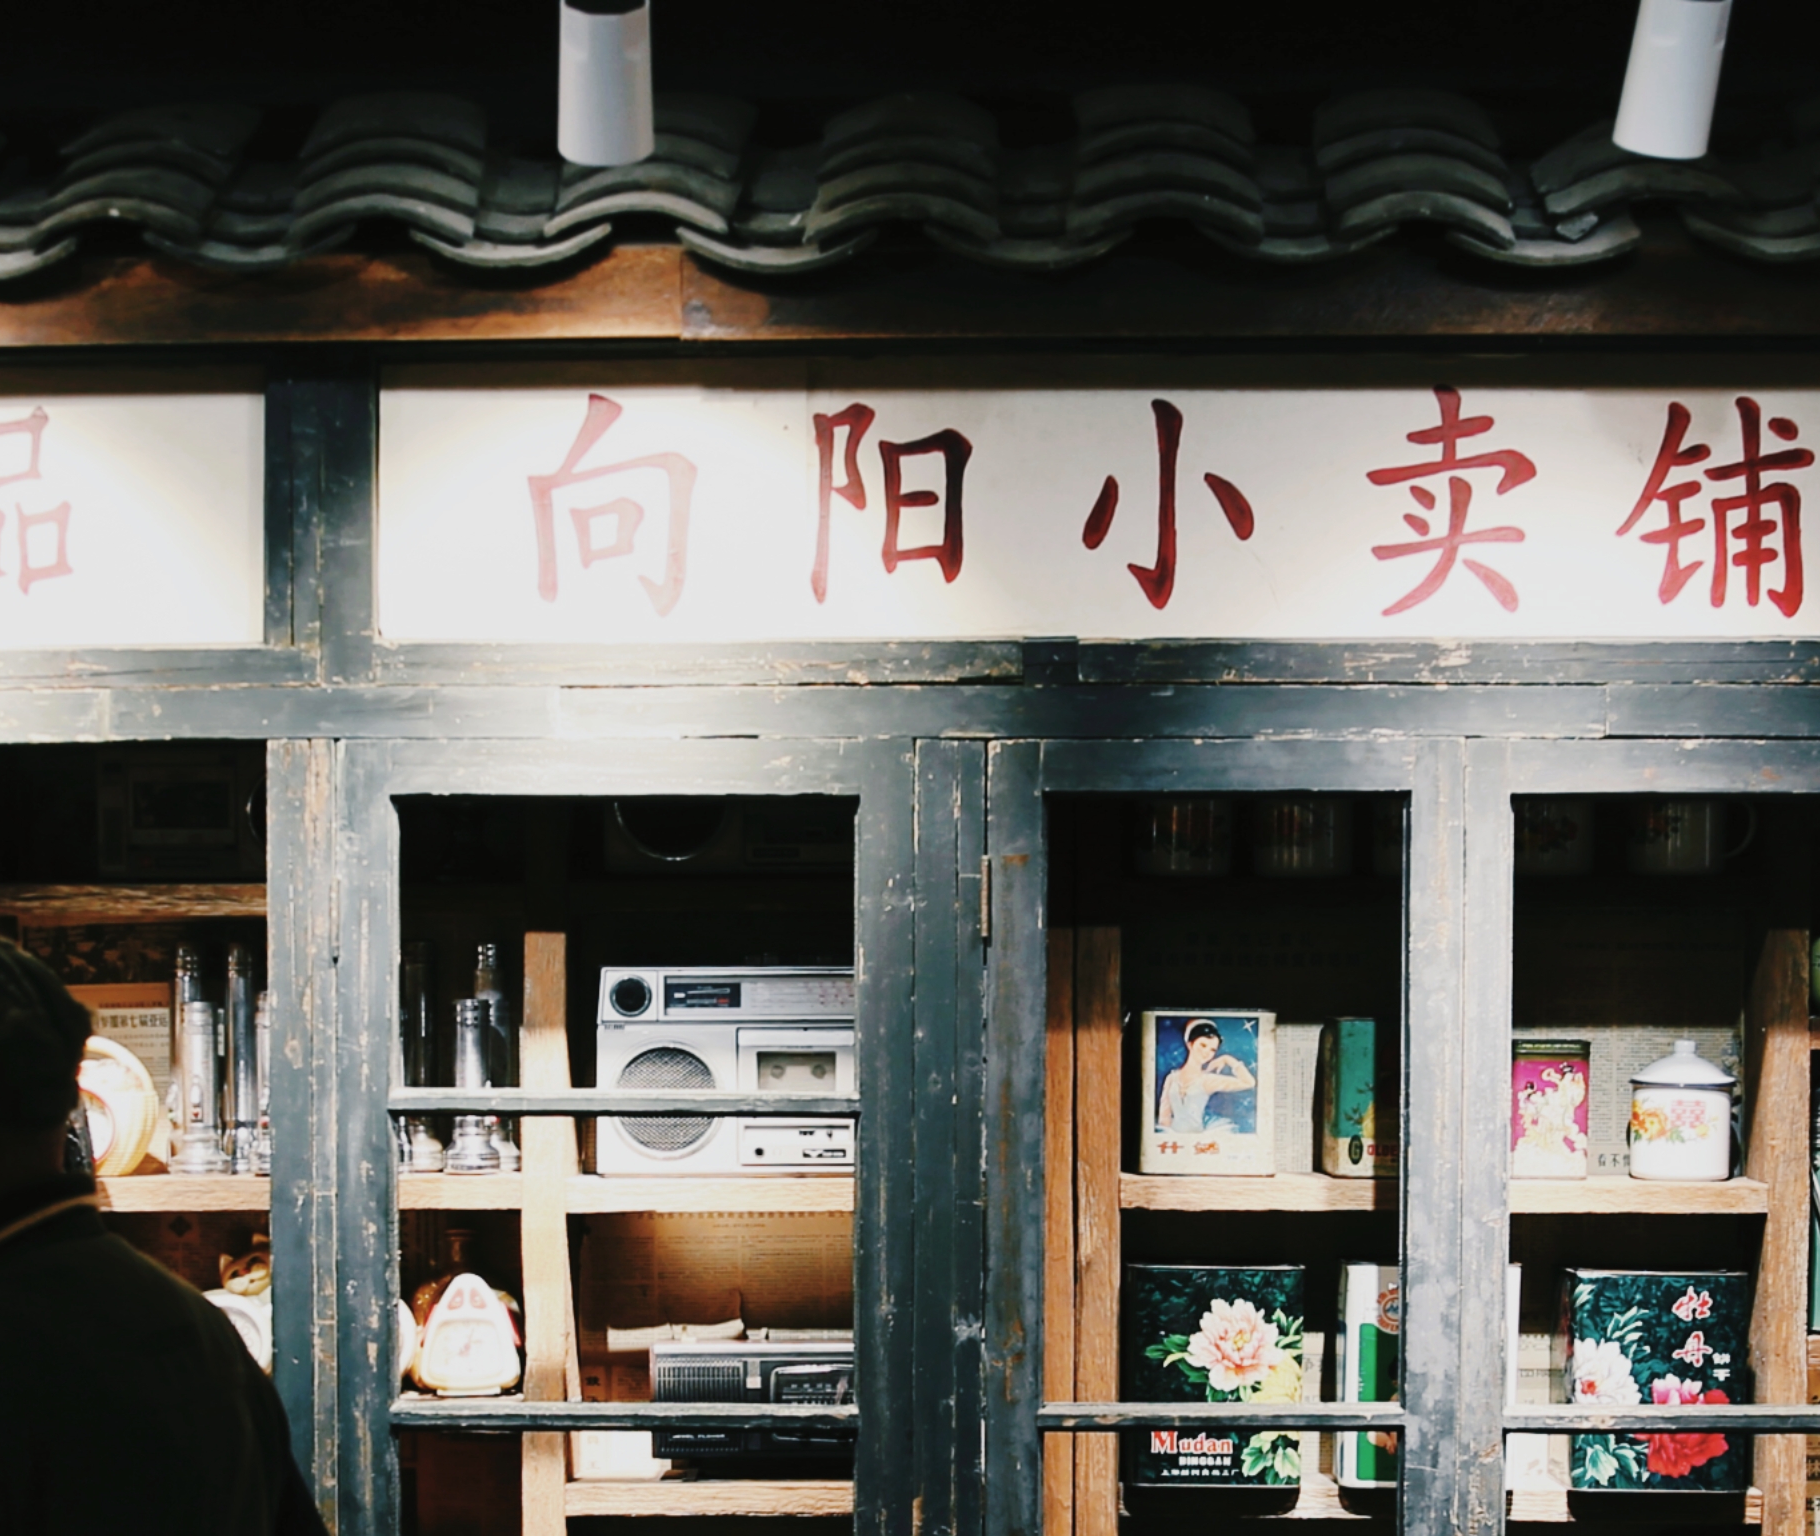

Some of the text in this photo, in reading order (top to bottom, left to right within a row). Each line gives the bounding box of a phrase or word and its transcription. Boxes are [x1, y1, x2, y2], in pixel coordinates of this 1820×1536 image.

[528, 384, 1817, 618] 向阳小卖铺
[1670, 1284, 1714, 1368] 牡丹
[1151, 1431, 1233, 1455] Mudan
